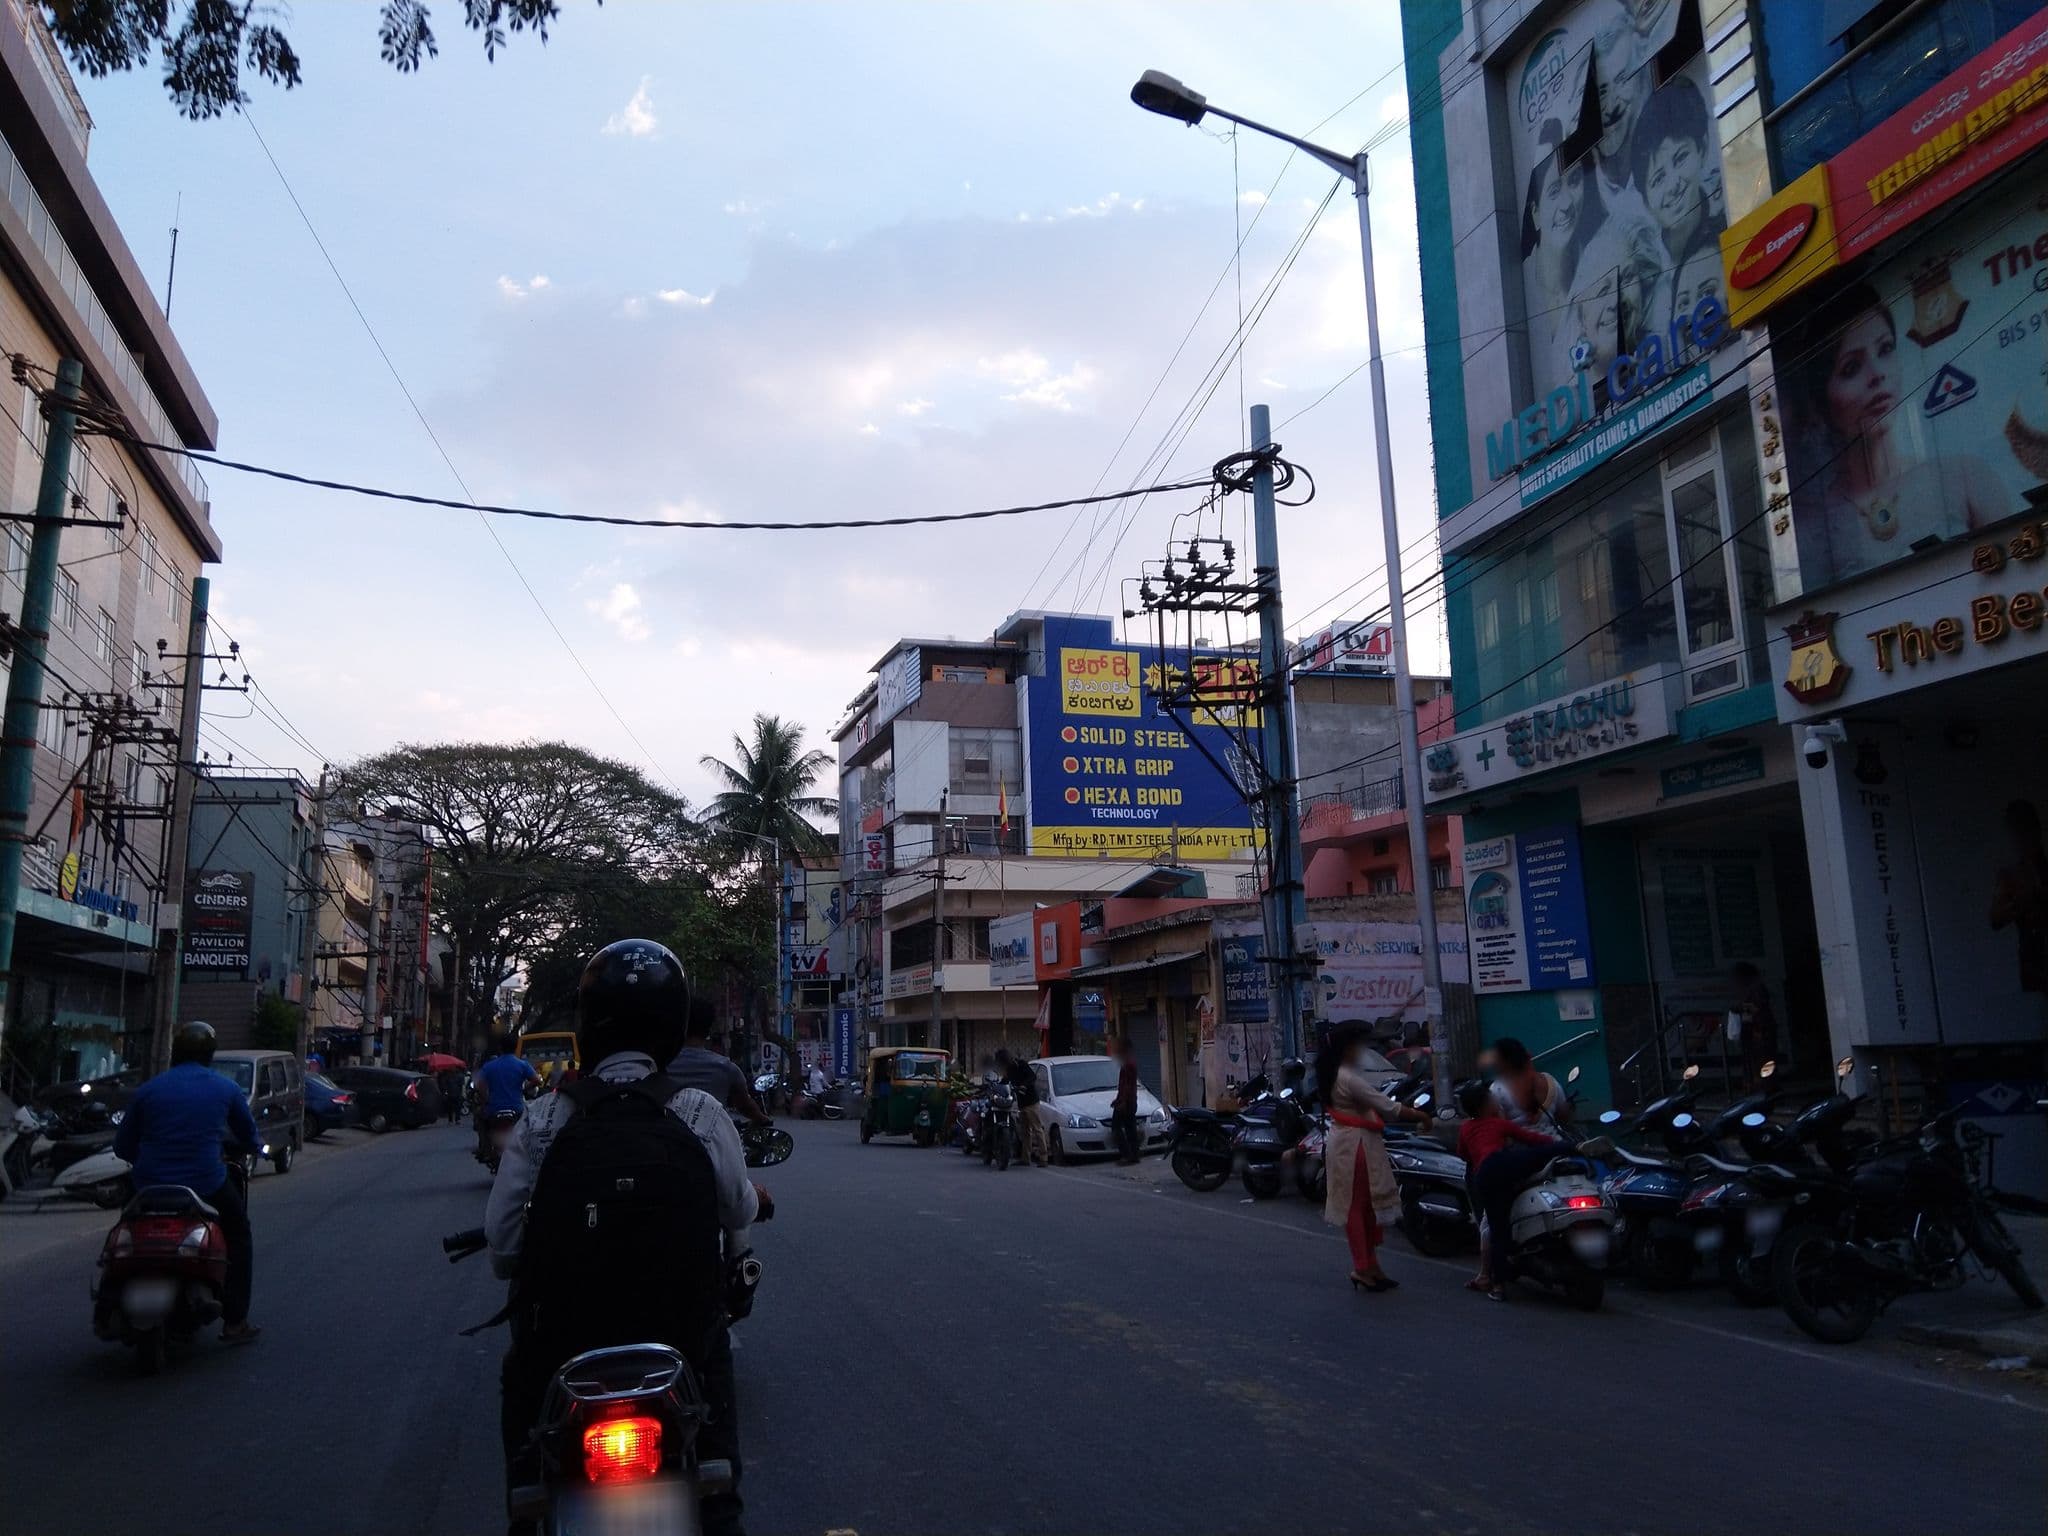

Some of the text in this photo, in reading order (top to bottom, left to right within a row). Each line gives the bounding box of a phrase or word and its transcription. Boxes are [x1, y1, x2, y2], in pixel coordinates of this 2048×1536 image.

[1766, 222, 1806, 255] Express
[1998, 320, 2026, 349] BIS
[1607, 295, 1725, 403] care
[1520, 373, 1708, 498] MULTI SPECIALITY CLINIC & DIAGNOSTICS
[1866, 616, 1965, 673] The
[1532, 680, 1636, 743] RAGHU
[1080, 726, 1190, 749] SOLID STEEL
[1082, 757, 1174, 776] XTRA GRIP
[1084, 787, 1183, 806] HEXA BOND
[1858, 789, 1891, 807] The
[1091, 808, 1160, 819] TECHNOLOGY
[1053, 833, 1073, 848] Mfg
[1109, 834, 1133, 845] TMT
[1136, 834, 1173, 846] STEELS
[1871, 810, 1892, 894] BEST
[193, 893, 248, 907] CINDERS
[191, 937, 245, 947] PAVILION
[184, 952, 249, 966] BANQUETS
[1886, 903, 1907, 1031] JEWELLERY
[1340, 976, 1414, 1000] Castrol
[840, 1012, 849, 1075] Panasonic
